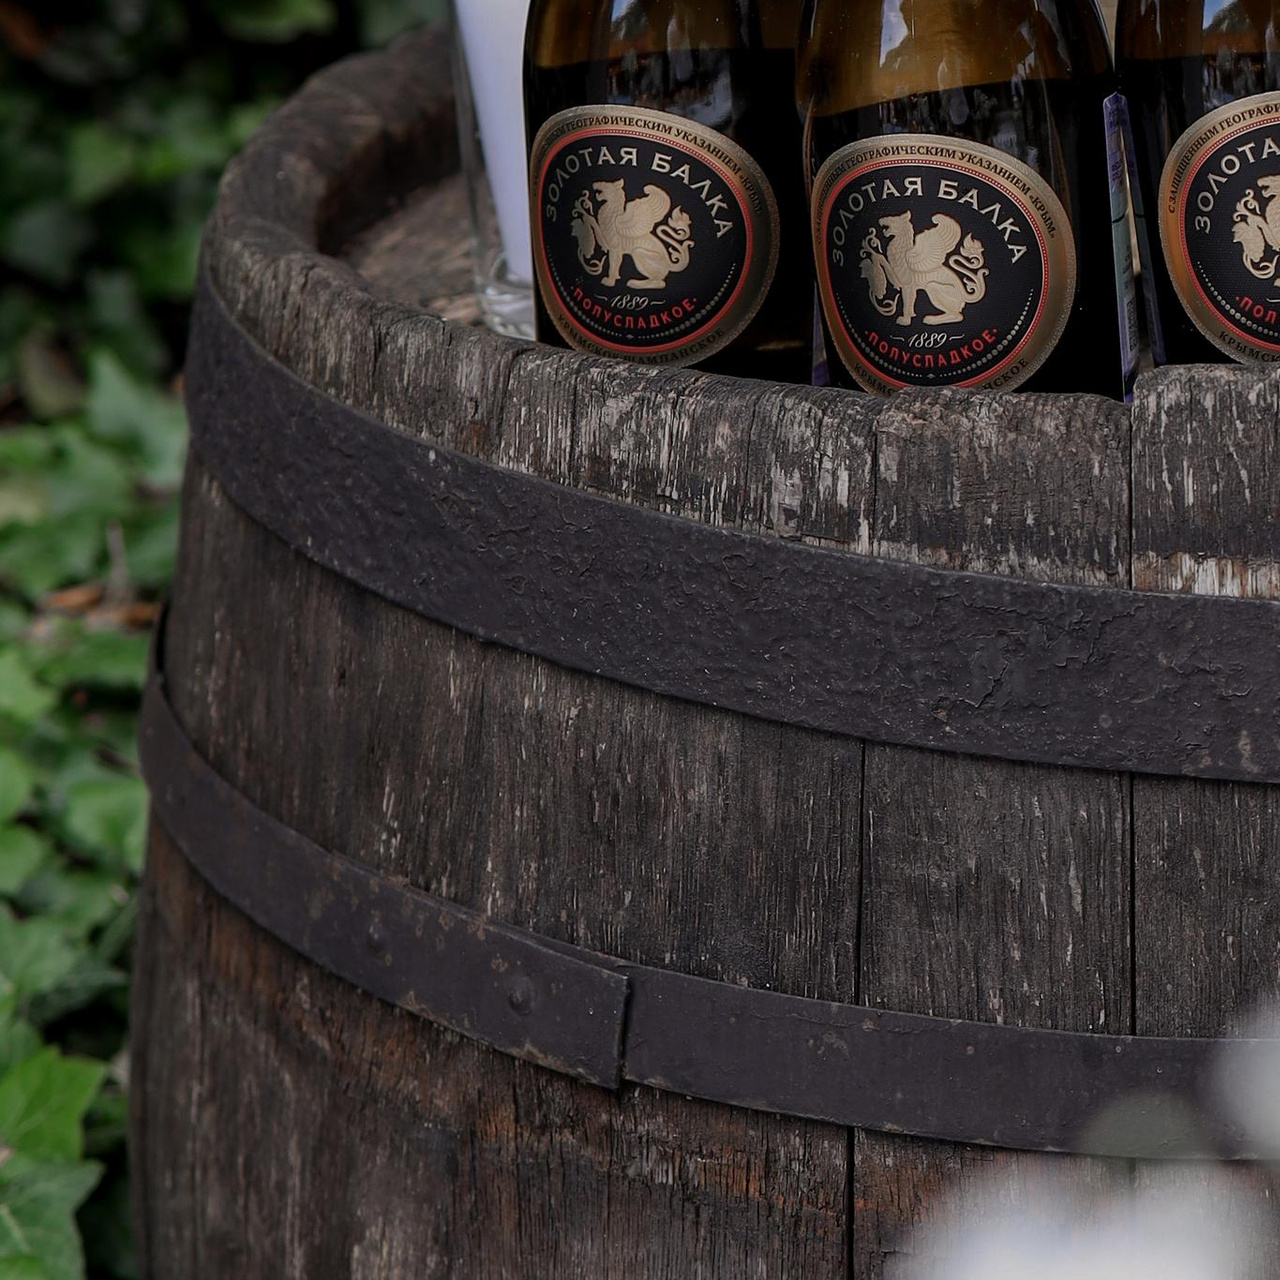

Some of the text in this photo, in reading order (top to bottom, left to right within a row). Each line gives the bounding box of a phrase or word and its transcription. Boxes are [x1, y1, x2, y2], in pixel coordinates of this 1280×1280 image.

[675, 127, 742, 175] УКАЗАНИЕМ
[739, 174, 762, 214] «КРЫМ
[846, 145, 956, 171] ГЕОГРАФИЧЕСКИМ
[959, 152, 1030, 194] УКАЗАНИЕМ
[1169, 125, 1219, 204] ЗАЩИЩЕННЫМ
[546, 146, 637, 223] ЗОЛОТАЯ
[651, 153, 733, 239] БАЛКА
[832, 177, 1028, 266] ЗОЛОТАЯ БАЛКА
[573, 290, 692, 329] ПОЛУСЛАДКОЕ
[610, 294, 649, 310] 1889
[869, 329, 994, 367] ПОЛУСЛАДКОЕ
[908, 331, 947, 347] 1889
